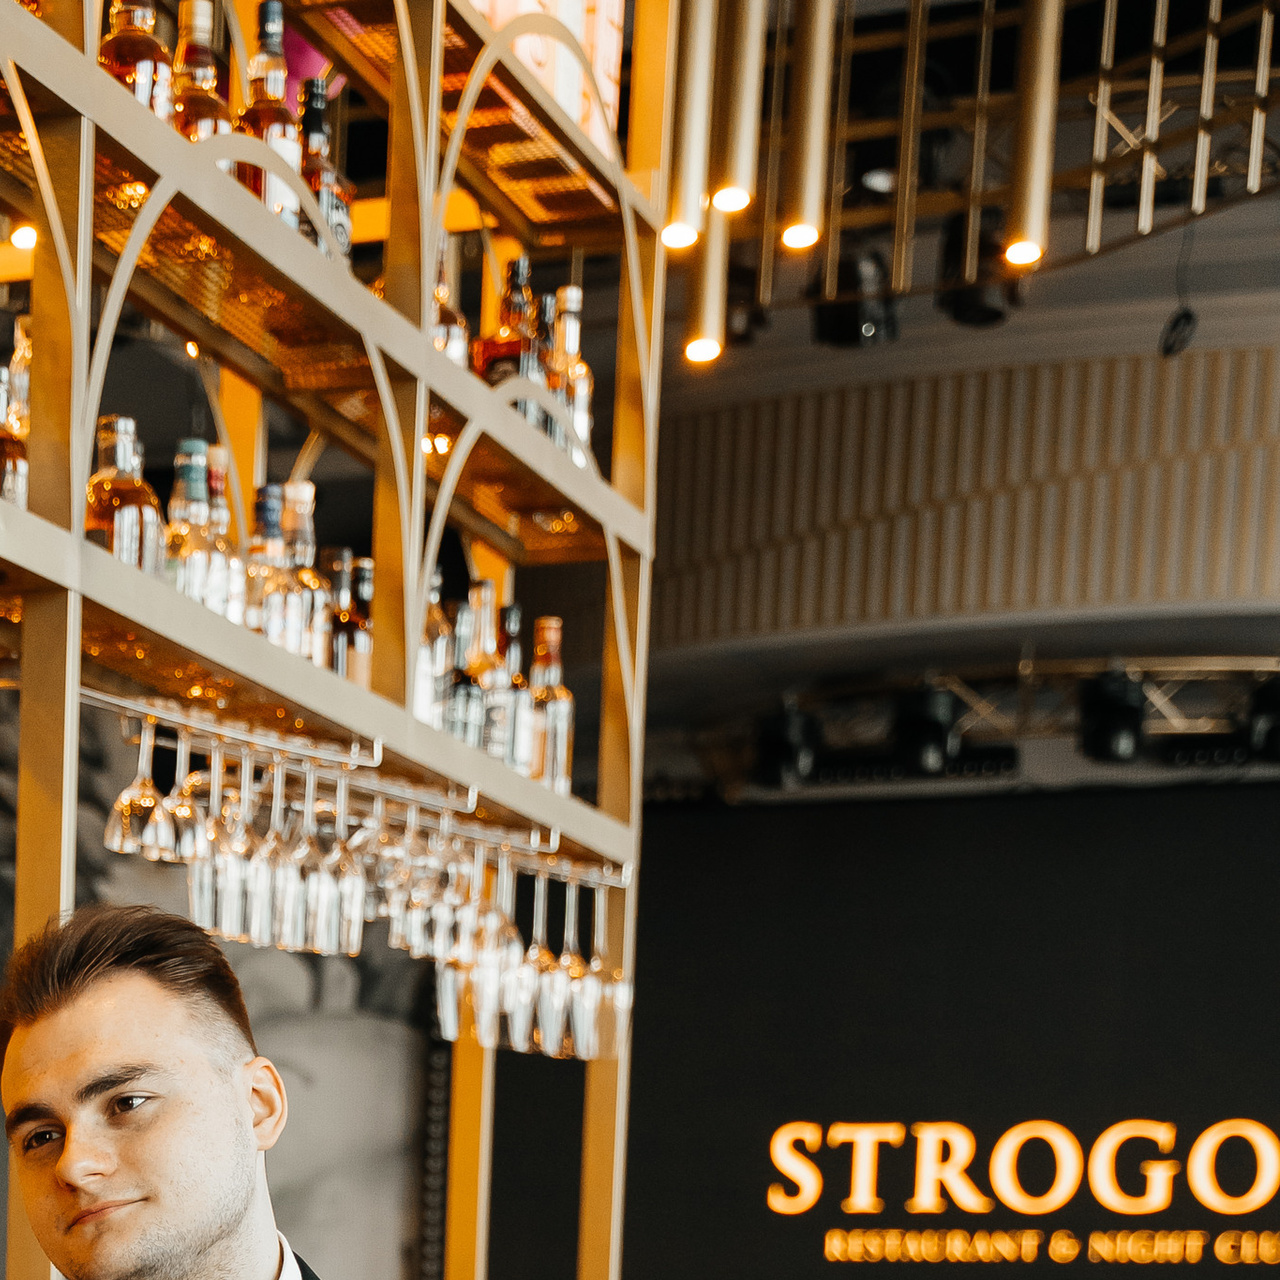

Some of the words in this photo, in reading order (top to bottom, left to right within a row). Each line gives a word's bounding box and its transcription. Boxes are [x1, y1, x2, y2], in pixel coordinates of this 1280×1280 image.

[767, 1119, 1280, 1215] STROGO
[825, 1228, 1044, 1263] RESTAURANT
[1048, 1229, 1082, 1264] &
[1088, 1230, 1211, 1264] NIGHT
